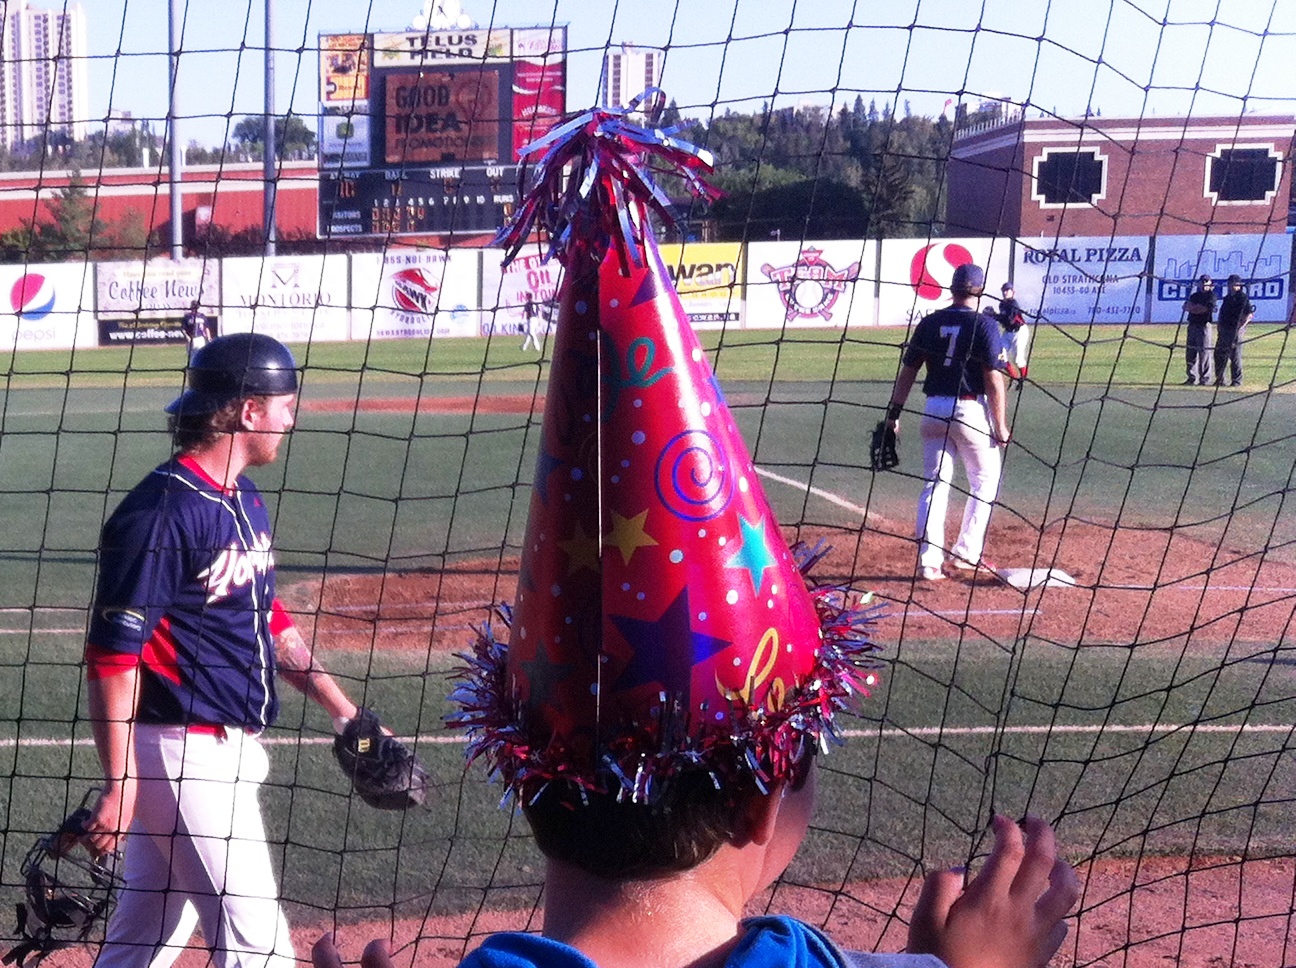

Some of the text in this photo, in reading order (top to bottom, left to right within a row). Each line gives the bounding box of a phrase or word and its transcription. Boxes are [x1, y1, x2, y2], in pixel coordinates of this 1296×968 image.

[406, 34, 478, 47] TELUS
[410, 47, 473, 60] FIELD
[395, 85, 451, 109] GOOD
[395, 112, 463, 134] IDEA
[430, 168, 461, 179] STRIKE
[486, 166, 504, 177] OUT
[493, 194, 514, 203] RUNS
[1023, 247, 1143, 264] ROYAL PIZZA
[666, 262, 736, 286] wan
[108, 280, 158, 302] Coffee
[11, 326, 56, 343] pepsi
[939, 325, 962, 367] 7
